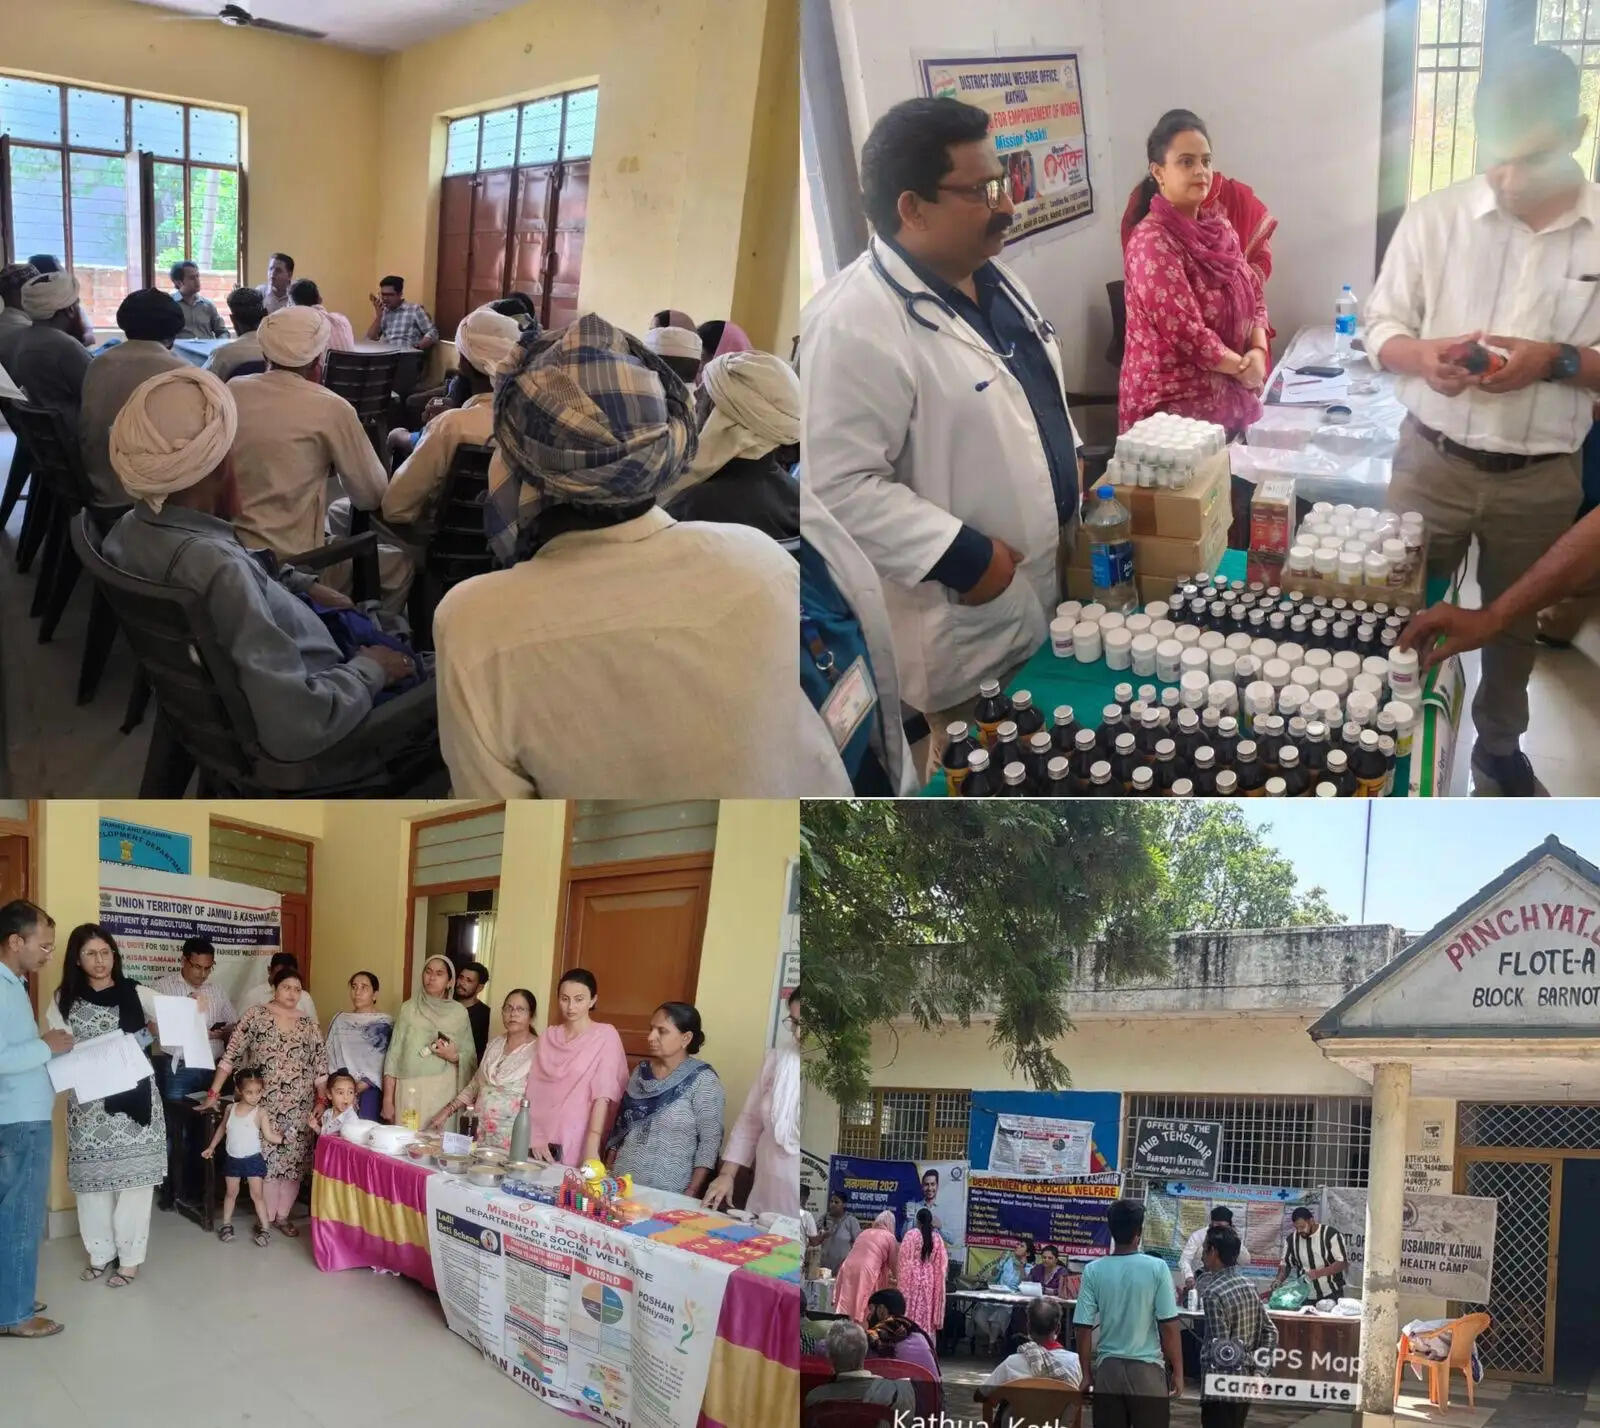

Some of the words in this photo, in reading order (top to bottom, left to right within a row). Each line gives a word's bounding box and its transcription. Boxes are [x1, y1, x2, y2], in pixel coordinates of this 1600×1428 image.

[958, 74, 989, 90] DISTRICT
[990, 72, 1012, 88] SOCIAL
[1012, 70, 1039, 85] WELFARE
[1005, 90, 1028, 104] KATHUA
[993, 111, 1007, 128] FOR
[995, 133, 1023, 149] Mission
[115, 896, 144, 909] UNION
[147, 900, 193, 915] TERRITORY
[194, 905, 205, 916] OF
[207, 907, 232, 920] JAMMU
[240, 912, 270, 922] KASHMIR
[141, 917, 149, 926] OF
[150, 918, 193, 930] AGRICULTURAL
[197, 923, 228, 934] PRODUCTION
[146, 942, 158, 951] FOR
[1472, 987, 1525, 1008] BLOCK
[1146, 1121, 1175, 1131] OFFICE
[1178, 1123, 1189, 1131] OF
[1193, 1124, 1211, 1134] THE
[1138, 1135, 1160, 1156] NAIB
[1161, 1131, 1212, 1160] TEHSILDAR
[879, 1181, 899, 1192] 2027
[972, 1177, 1025, 1192] DEPARTMENT
[1040, 1184, 1072, 1195] SOCIAL
[1074, 1186, 1116, 1197] WELFARE
[1084, 1173, 1119, 1185] KASHMIR
[487, 1203, 539, 1229] Mission
[555, 1225, 627, 1257] POSHAN
[465, 1206, 528, 1234] DEPARTMENT
[530, 1228, 546, 1239] OF
[549, 1235, 592, 1256] SOCIAL
[596, 1251, 655, 1283] WELFARE
[550, 1243, 588, 1261] KASHMIR
[1401, 1238, 1446, 1257] USBANDRY,
[1449, 1243, 1482, 1260] KATHUA
[586, 1266, 621, 1286] VHSND
[1400, 1258, 1436, 1271] HEALTH
[1439, 1262, 1469, 1274] CAMP
[1399, 1276, 1432, 1287] ARNOTI
[638, 1290, 675, 1313] POSHAN
[637, 1301, 675, 1326] Abhiyaan
[512, 1366, 582, 1407] PROJECT
